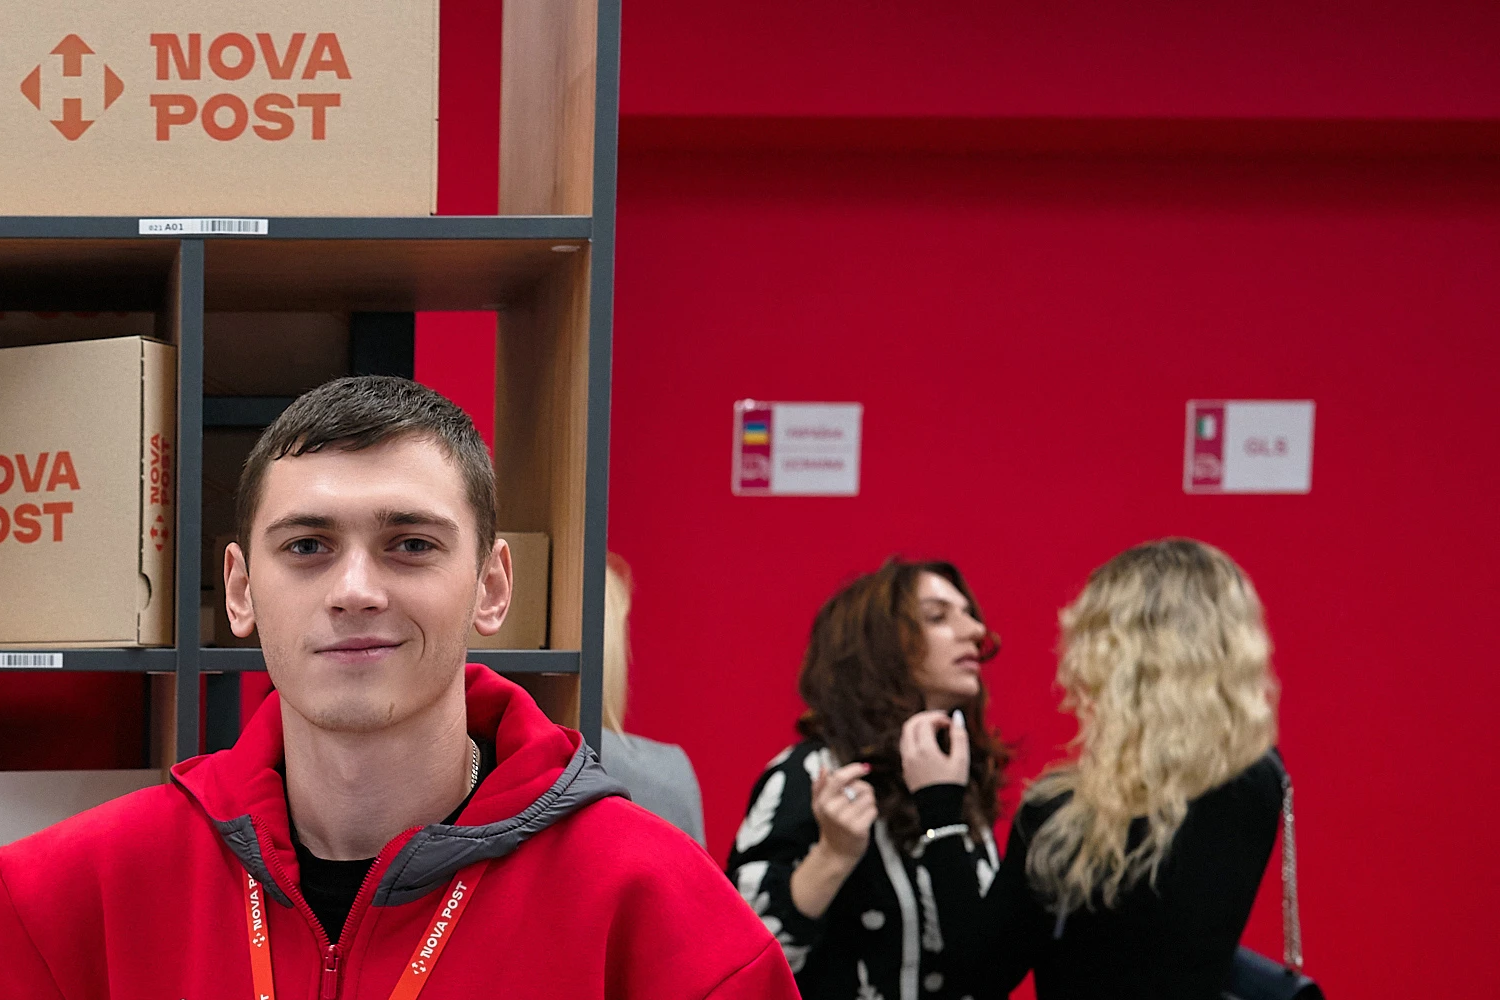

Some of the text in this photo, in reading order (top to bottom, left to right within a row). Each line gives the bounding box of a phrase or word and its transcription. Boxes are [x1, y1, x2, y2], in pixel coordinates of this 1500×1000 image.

[150, 32, 352, 80] NOVA
[150, 94, 341, 141] POST
[165, 223, 183, 231] A01
[150, 433, 160, 505] NOVA
[252, 890, 262, 931] NOVA
[420, 881, 467, 959] NOVA POST
